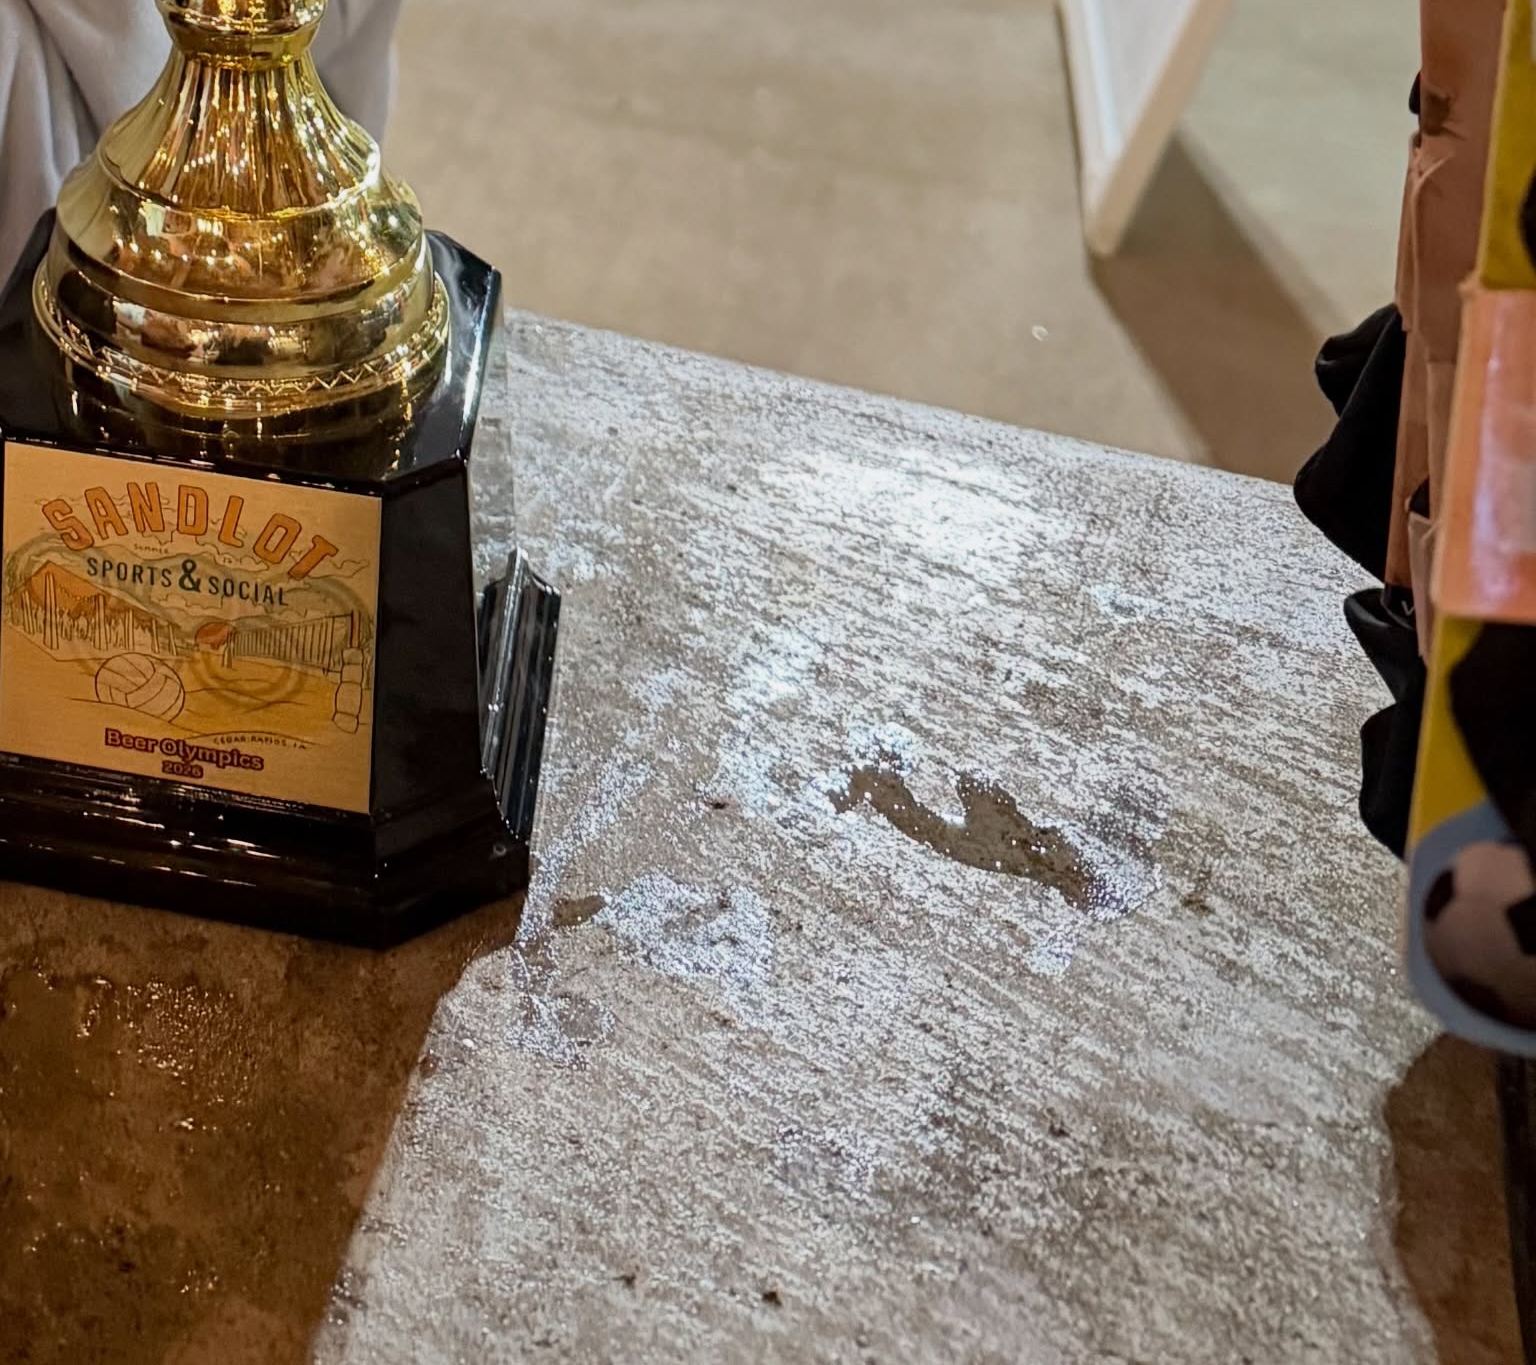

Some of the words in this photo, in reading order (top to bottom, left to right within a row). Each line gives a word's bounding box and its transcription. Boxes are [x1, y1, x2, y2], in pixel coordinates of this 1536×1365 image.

[42, 482, 338, 581] SANDLOT
[86, 557, 172, 589] SPORTS
[179, 559, 202, 593] &
[208, 580, 289, 607] SOCIAL
[105, 727, 157, 755] Beer
[159, 737, 265, 771] Olympics
[162, 759, 204, 780] 2026
